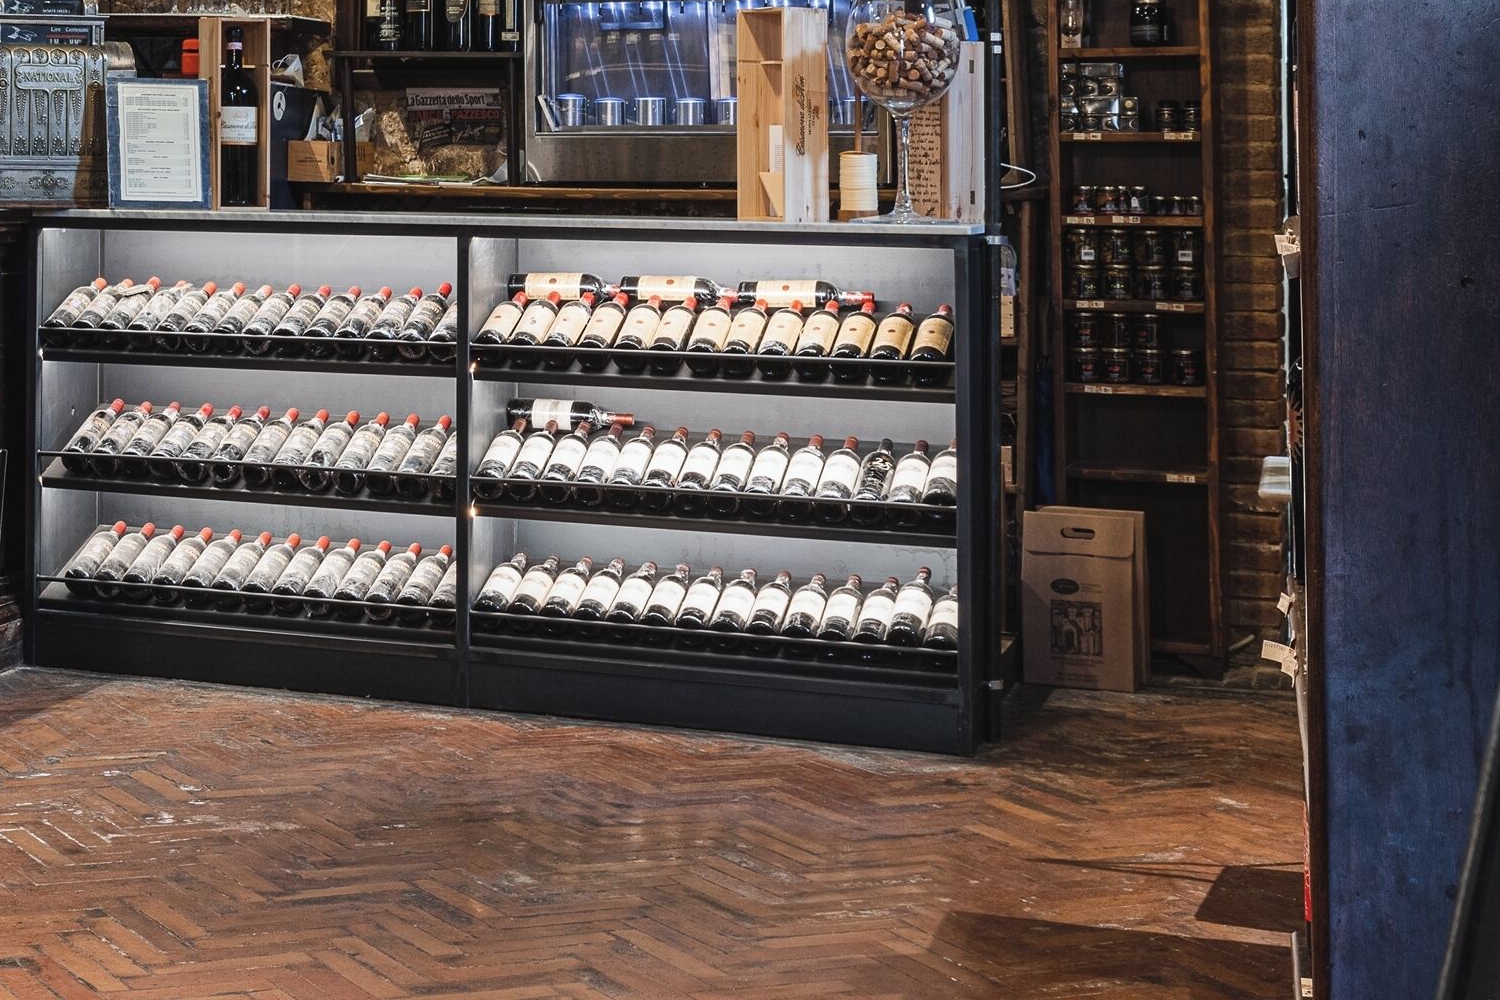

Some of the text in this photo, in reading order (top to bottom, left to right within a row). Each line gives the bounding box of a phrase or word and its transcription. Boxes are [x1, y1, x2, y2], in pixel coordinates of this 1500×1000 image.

[22, 71, 74, 83] NATIONAL
[415, 94, 447, 106] Gazzetta
[447, 94, 465, 105] dello
[465, 94, 486, 106] Sport
